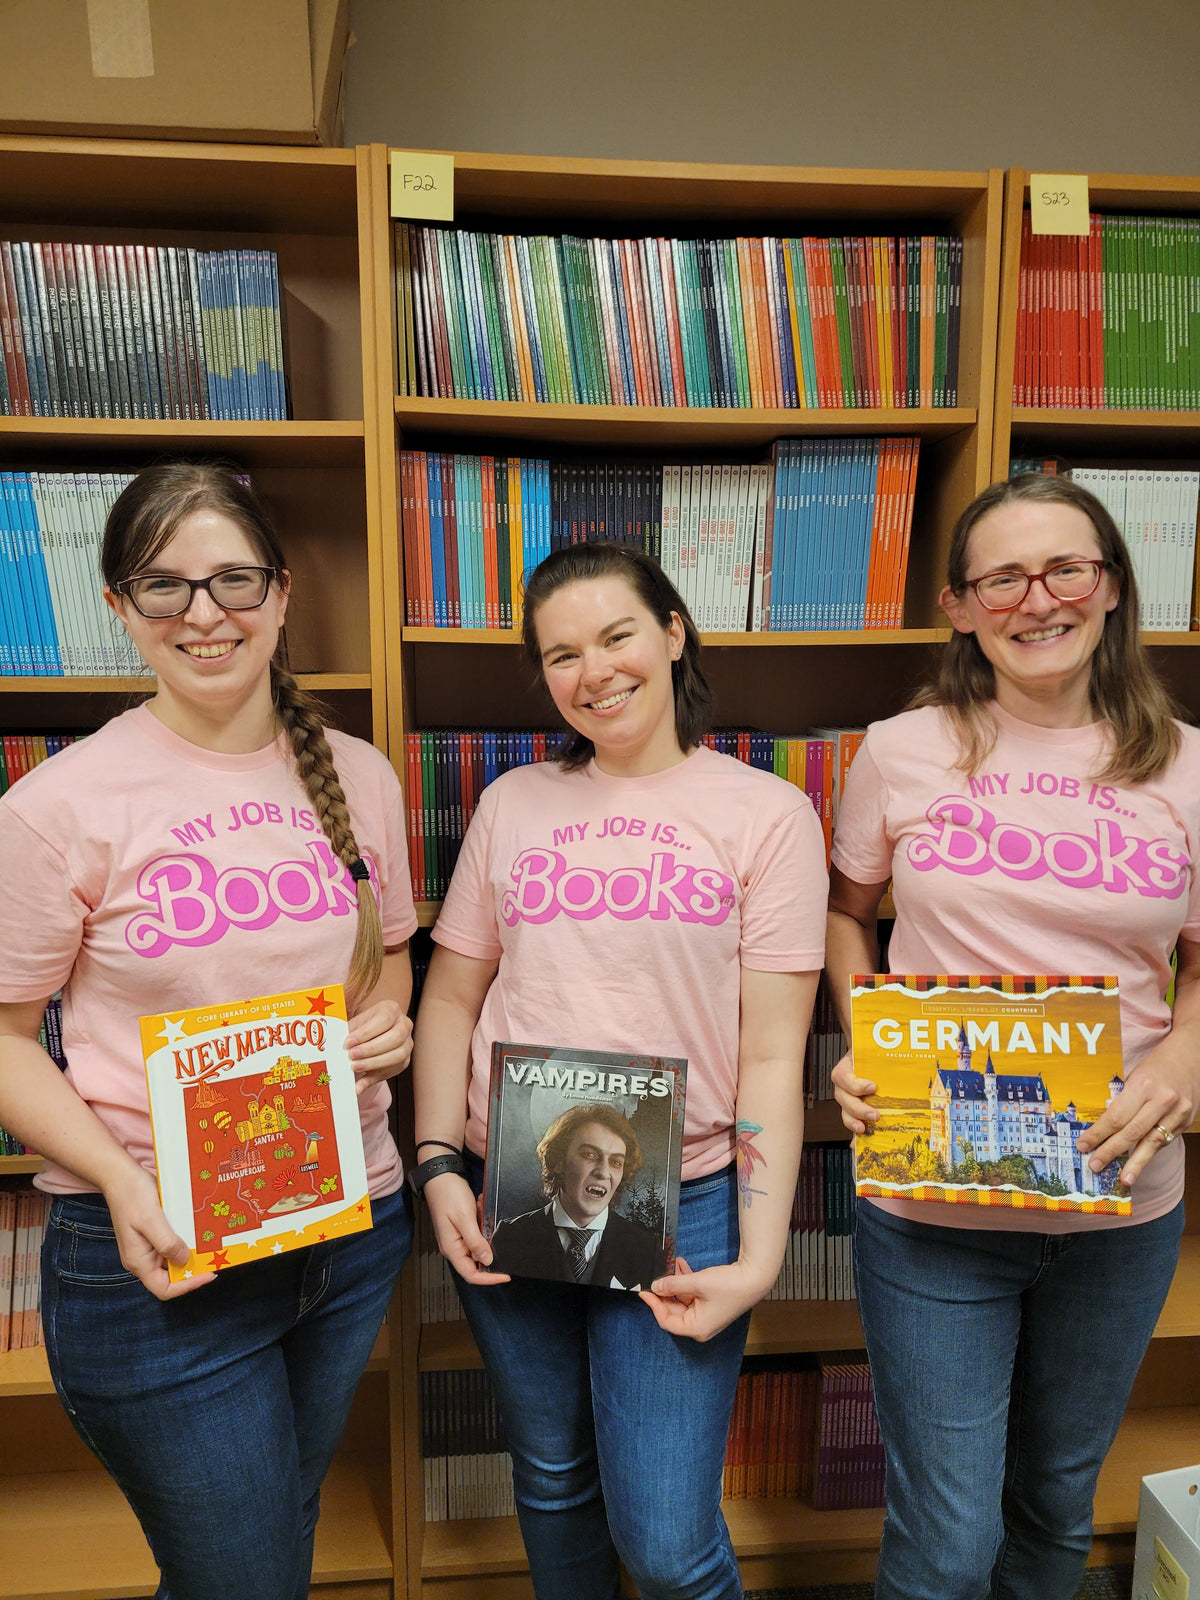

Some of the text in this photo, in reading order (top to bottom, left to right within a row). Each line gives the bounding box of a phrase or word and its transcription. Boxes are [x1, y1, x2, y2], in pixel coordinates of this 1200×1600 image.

[404, 174, 437, 191] F22
[1042, 192, 1070, 206] S23
[969, 772, 1137, 819] MY JOB IS...
[171, 814, 217, 847] MY
[228, 802, 284, 832] JOB
[553, 816, 692, 851] MY JOB IS...
[907, 795, 1190, 900] Books
[501, 847, 734, 927] Books
[50, 1009, 58, 1035] DINOSAUR
[197, 1014, 217, 1023] CORE
[220, 1009, 247, 1019] LIBRARY
[272, 1000, 295, 1010] STATES
[171, 1018, 327, 1084] NEW MEXICO
[872, 1018, 1106, 1055] GERMANY
[280, 1081, 296, 1091] TAOS
[506, 1062, 671, 1100] VAMPIRES
[254, 1132, 284, 1146] SANTA FE
[218, 1164, 266, 1183] ALBUQUERQUE
